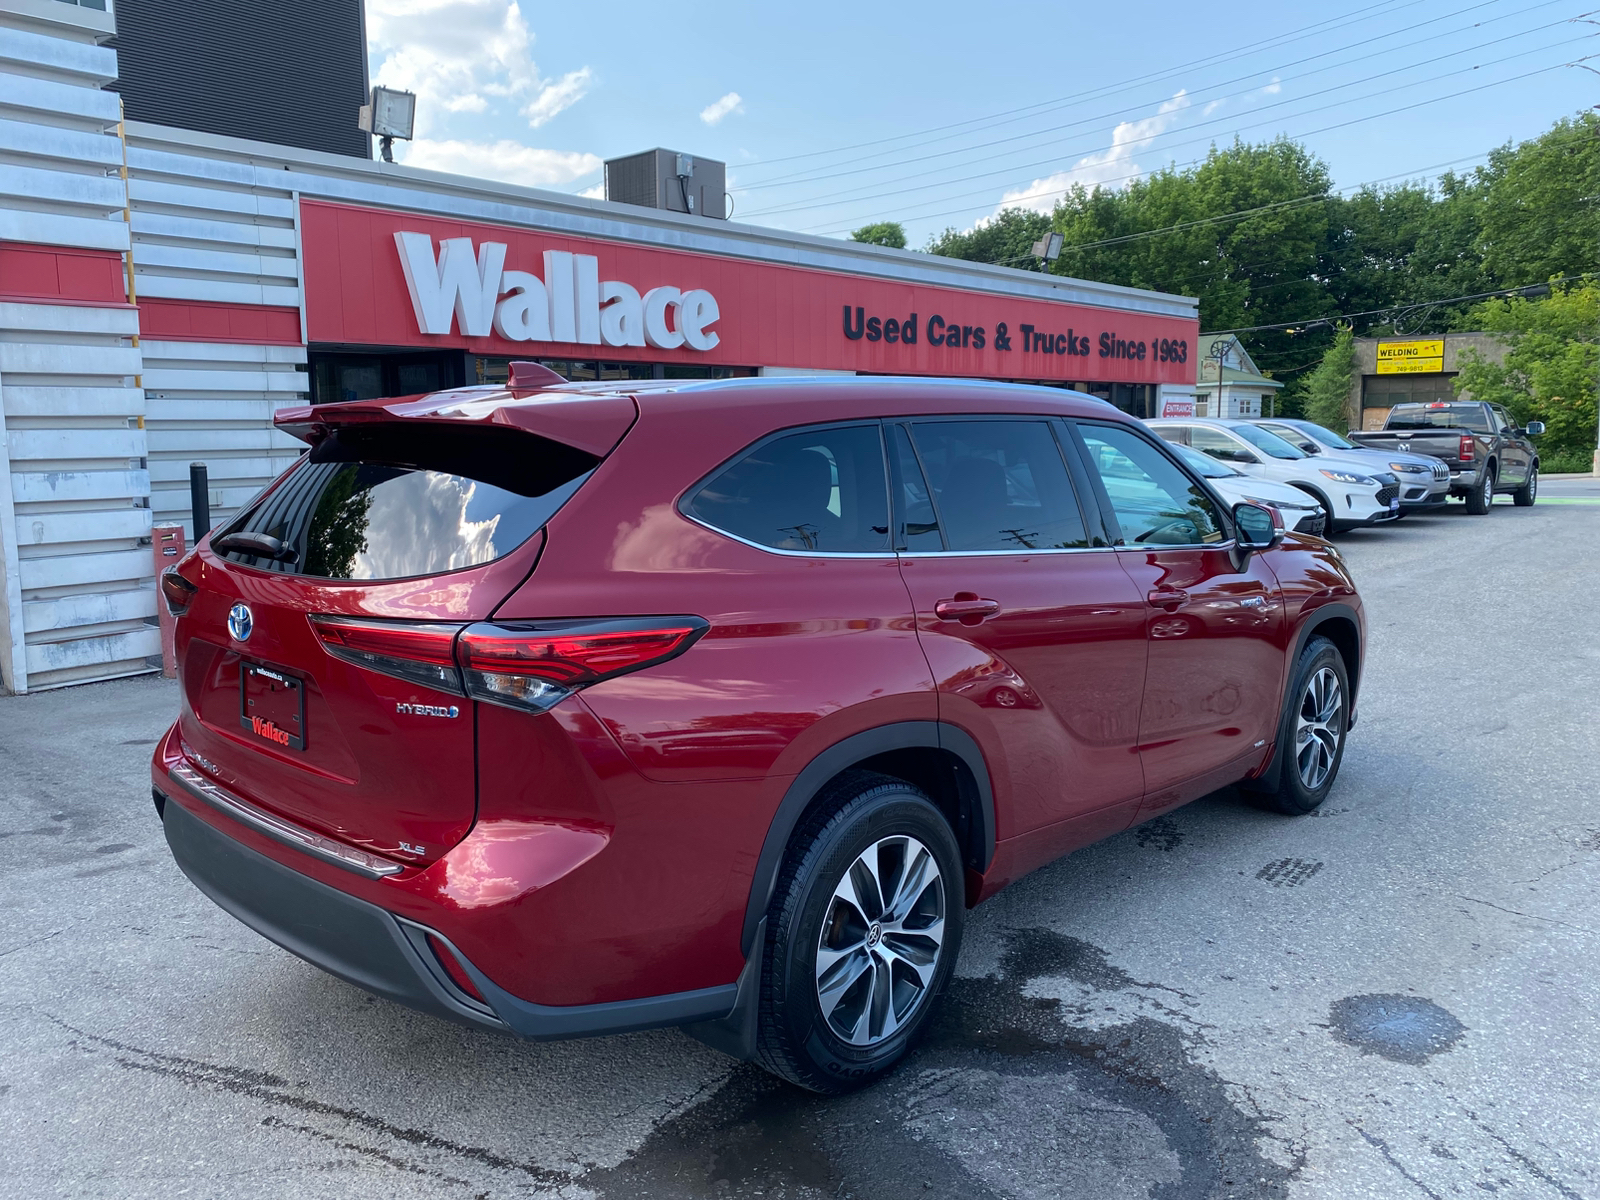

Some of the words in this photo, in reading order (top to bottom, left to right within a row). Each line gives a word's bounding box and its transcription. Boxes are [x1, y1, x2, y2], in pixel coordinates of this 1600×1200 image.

[393, 231, 720, 351] Wallace
[843, 305, 917, 344] Used
[927, 314, 986, 350] Cars
[994, 322, 1012, 351] &
[1020, 324, 1090, 356] Trucks
[1099, 332, 1146, 360] Since
[1151, 338, 1187, 363] 1963
[1380, 348, 1418, 357] WELDING
[1166, 404, 1192, 413] ENTRANCE
[396, 702, 448, 717] HYBRID
[252, 716, 289, 746] Wallace
[398, 841, 426, 856] XLE
